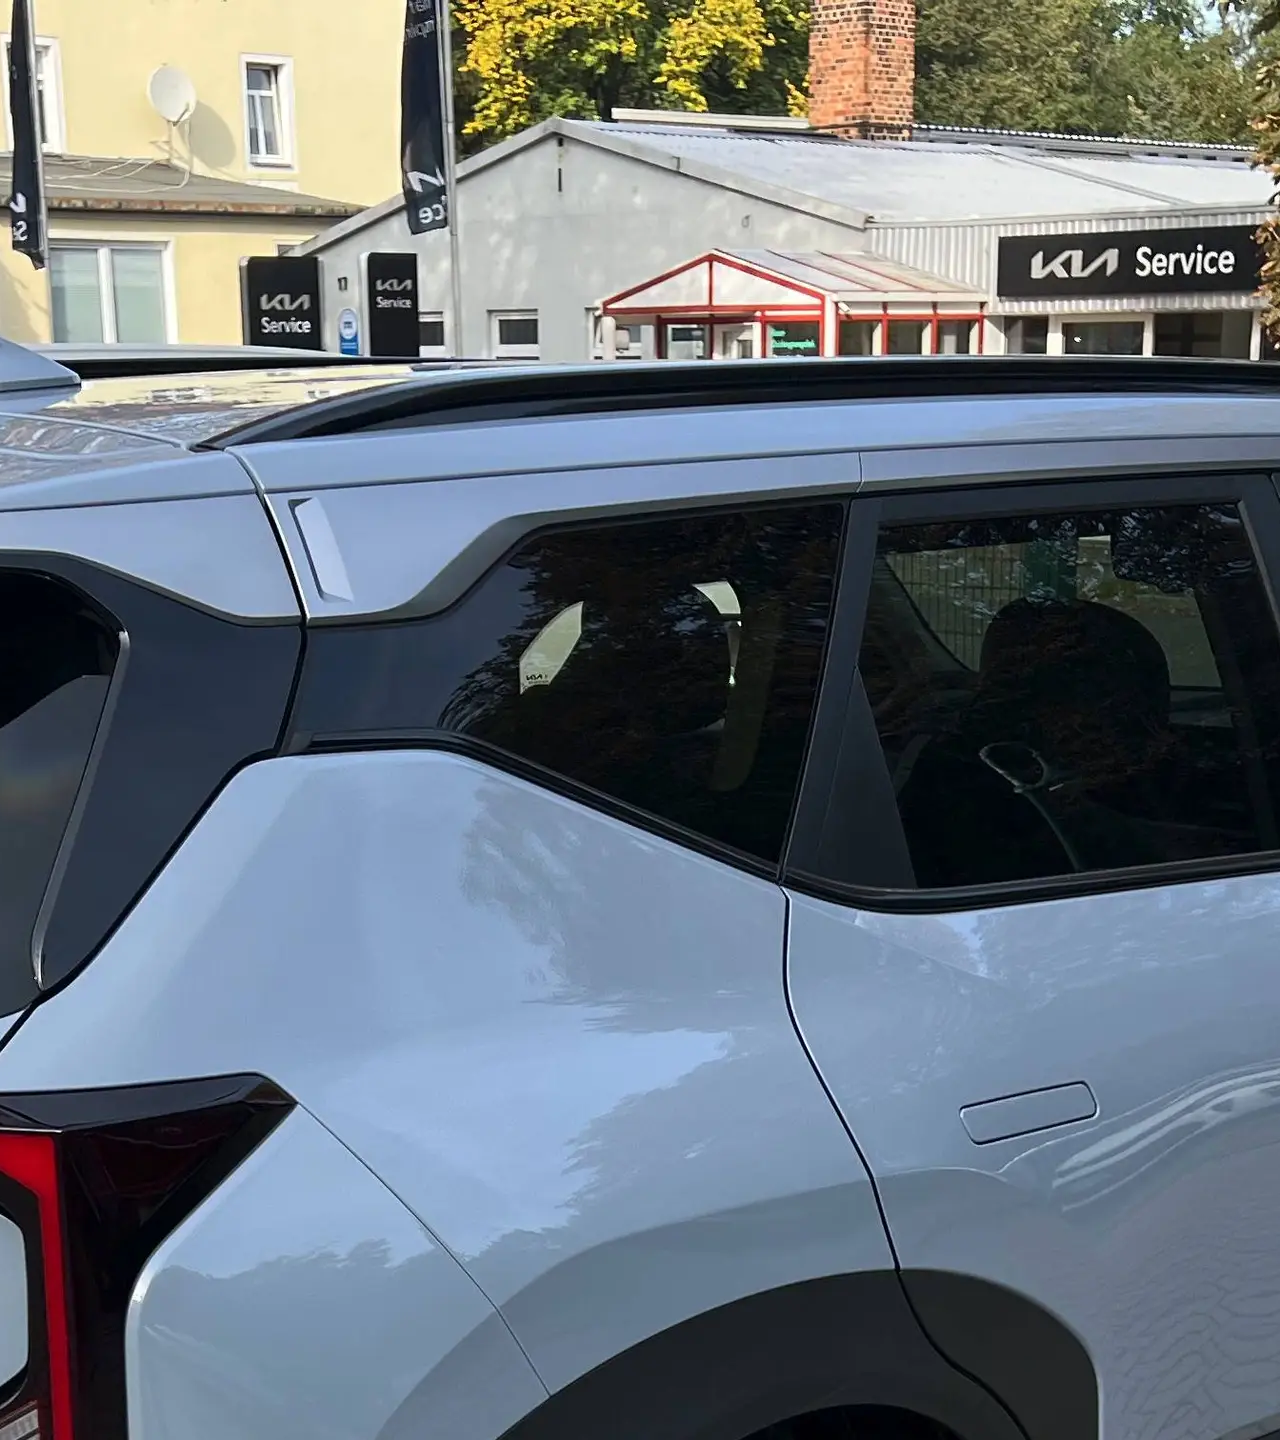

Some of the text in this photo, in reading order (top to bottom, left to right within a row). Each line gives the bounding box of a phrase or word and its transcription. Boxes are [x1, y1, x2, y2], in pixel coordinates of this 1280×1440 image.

[1030, 244, 1236, 280] KIA Service
[376, 278, 413, 291] KIA
[260, 293, 312, 310] KIA
[376, 296, 412, 309] Service
[261, 316, 312, 333] Service
